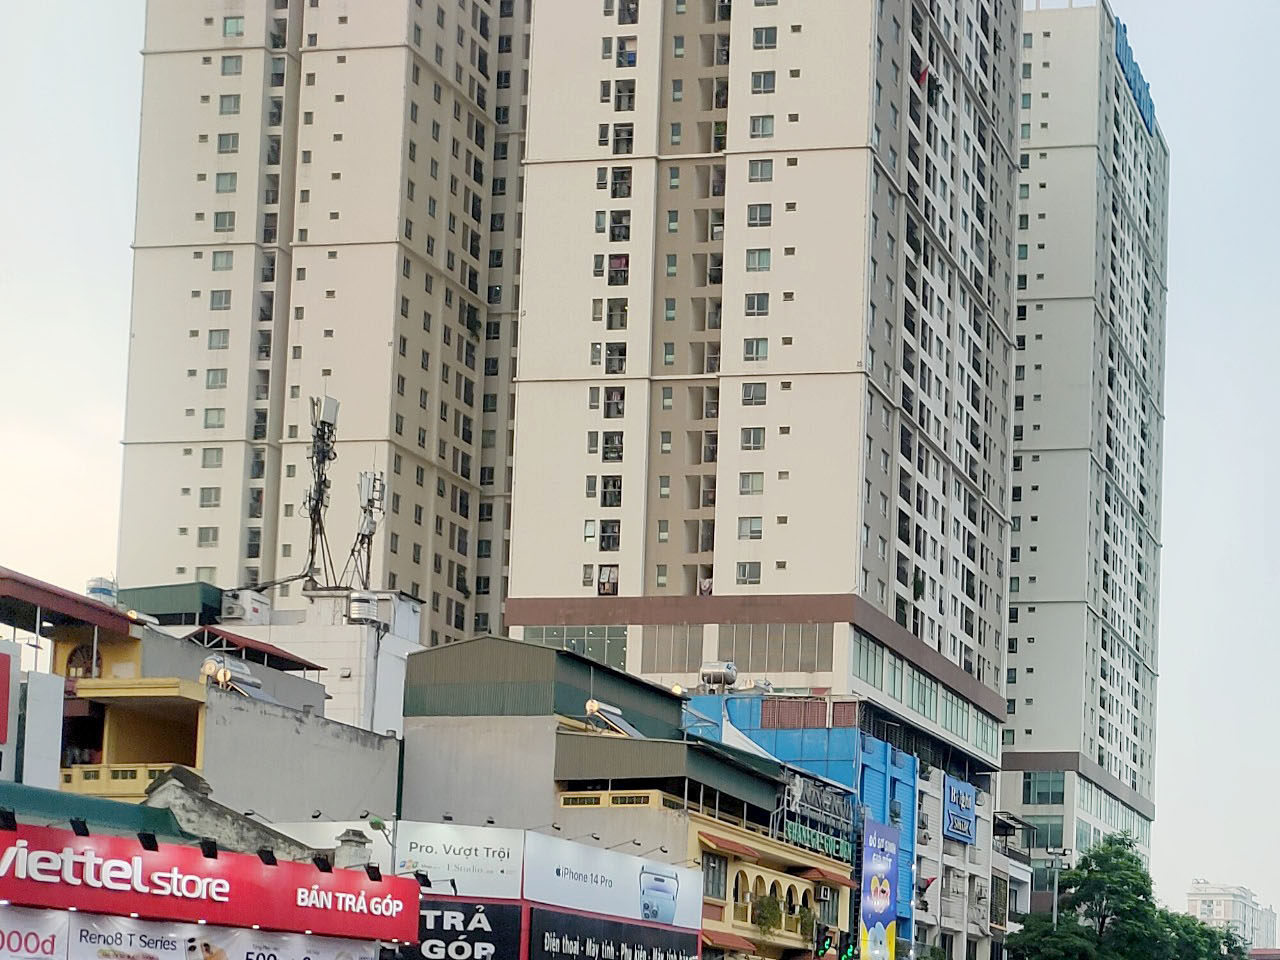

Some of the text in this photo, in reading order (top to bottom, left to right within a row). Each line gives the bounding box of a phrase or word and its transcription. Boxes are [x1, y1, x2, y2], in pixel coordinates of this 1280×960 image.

[408, 841, 510, 862] Pro. Vượt Trội
[150, 867, 230, 902] store
[561, 866, 613, 889] iPhone 14 Pro
[335, 890, 368, 915] TRẢ
[370, 894, 403, 918] GÓP
[419, 904, 493, 932] TRẢ
[79, 928, 177, 951] Reno8 T Series
[420, 934, 496, 960] GÓP
